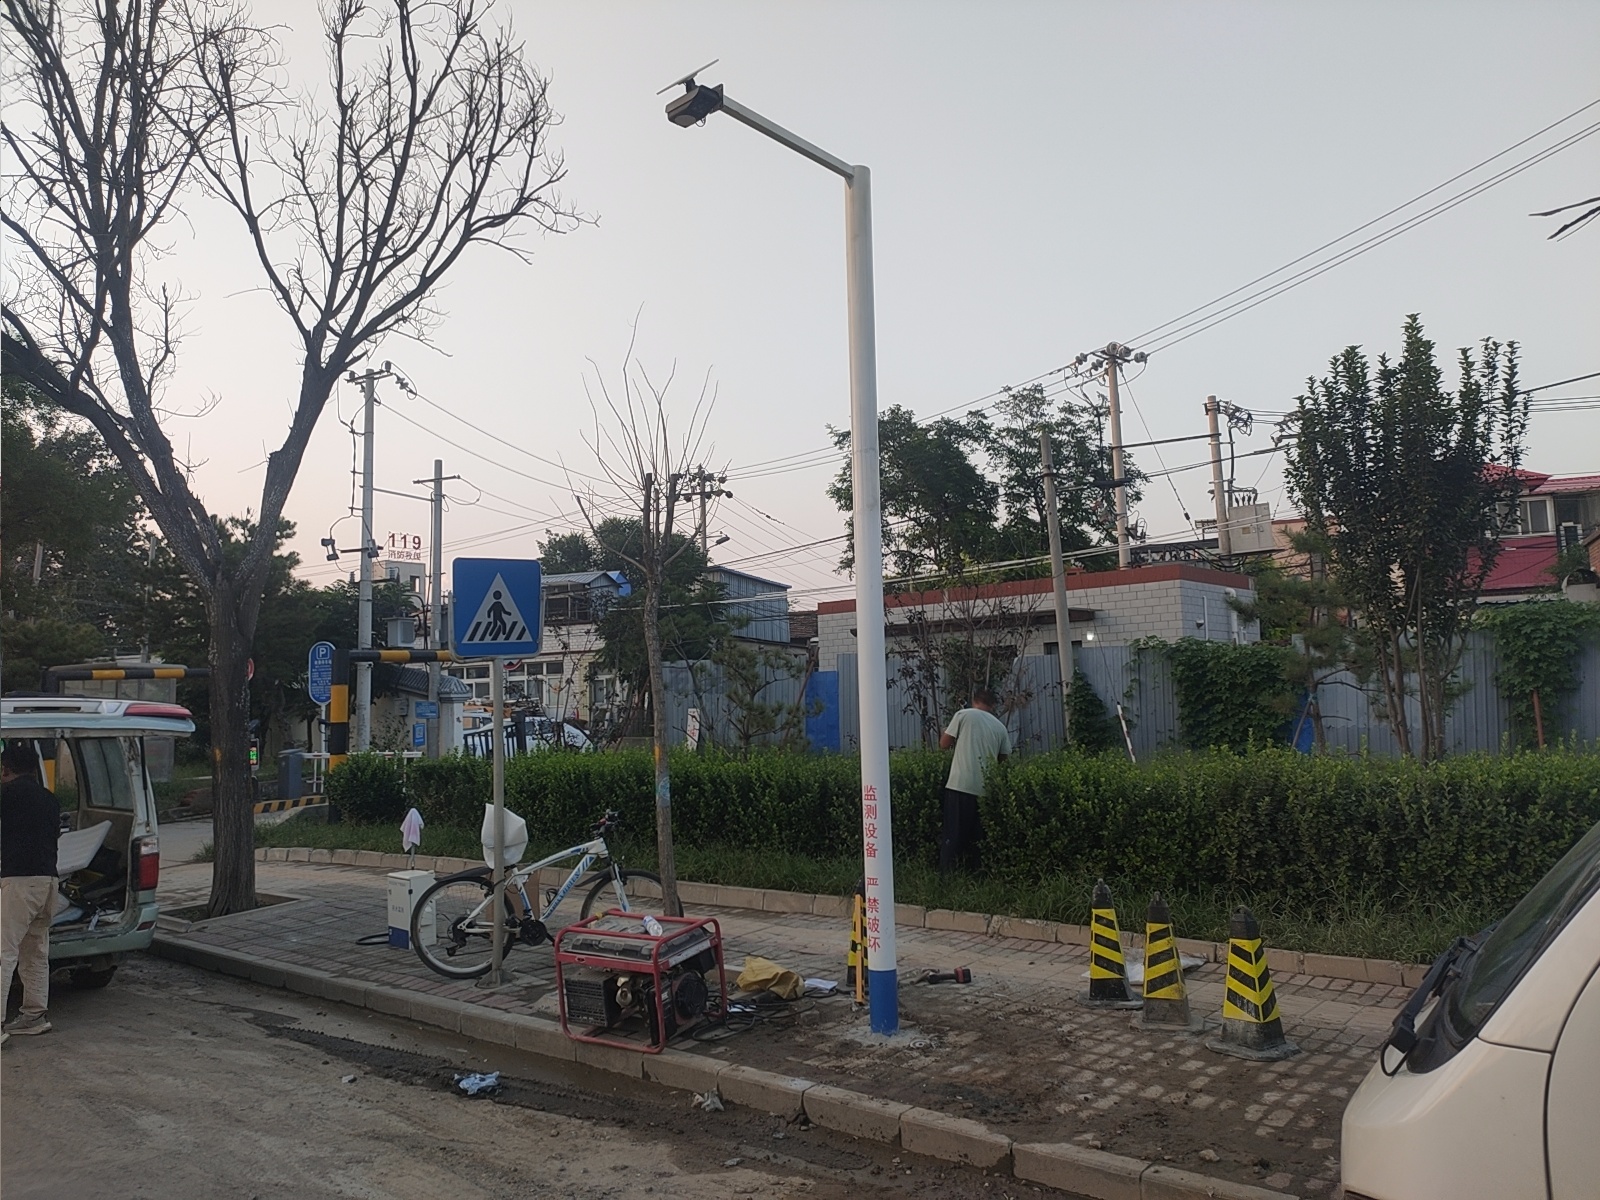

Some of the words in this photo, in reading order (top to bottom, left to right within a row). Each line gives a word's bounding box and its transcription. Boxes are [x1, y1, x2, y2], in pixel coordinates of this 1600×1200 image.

[389, 533, 421, 550] 119
[864, 784, 878, 858] 监测设备
[867, 877, 880, 952] 严禁破坏
